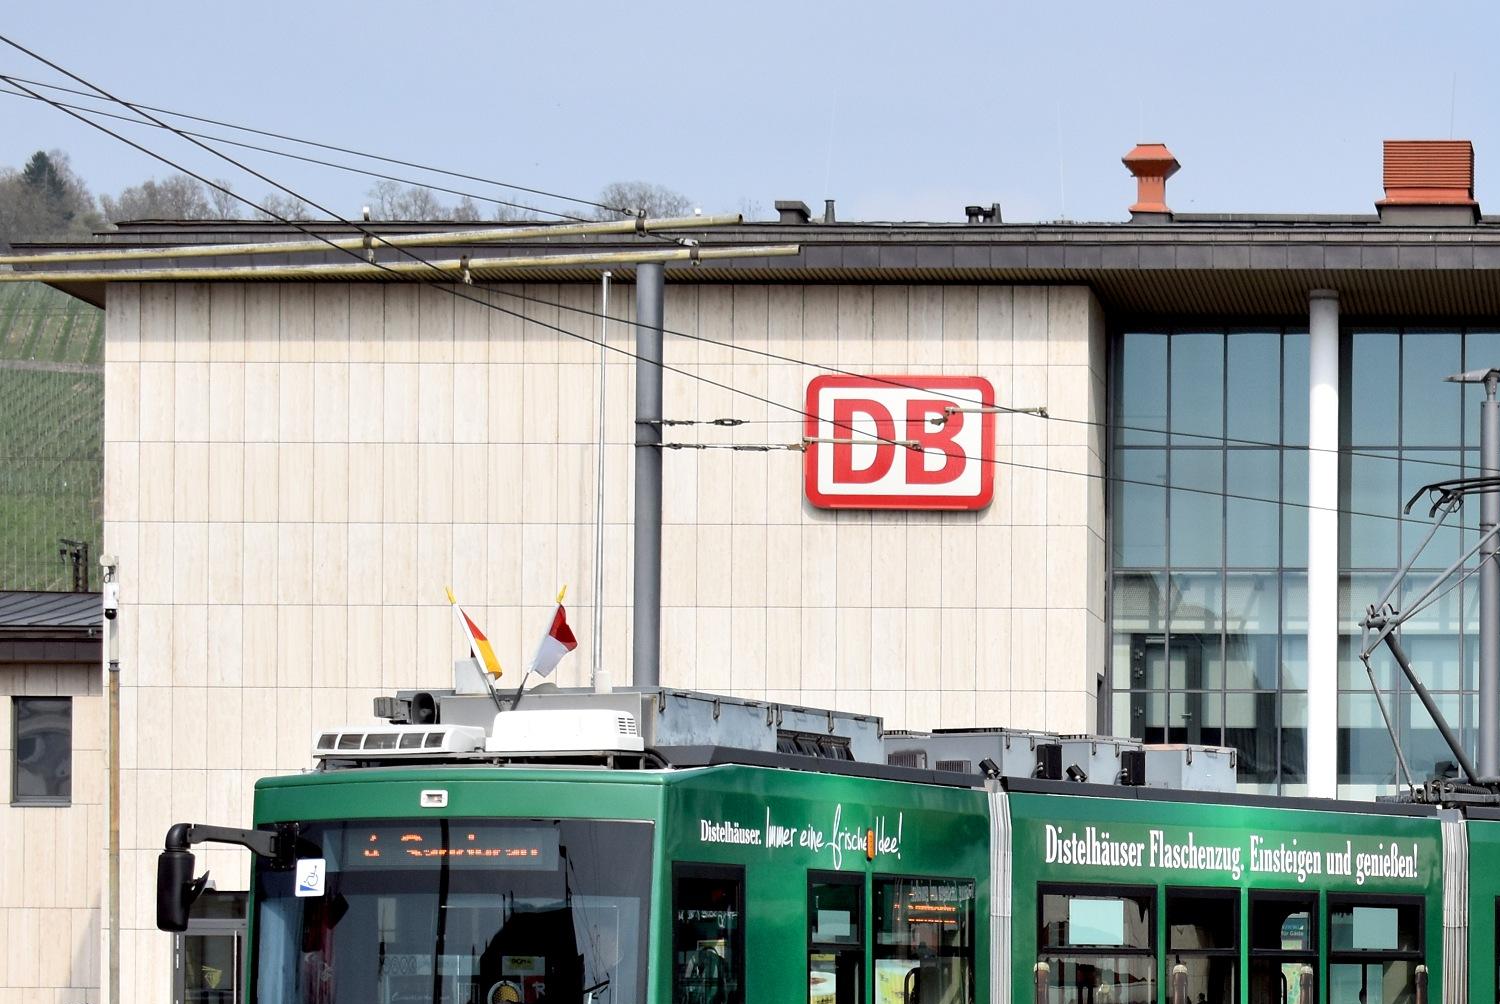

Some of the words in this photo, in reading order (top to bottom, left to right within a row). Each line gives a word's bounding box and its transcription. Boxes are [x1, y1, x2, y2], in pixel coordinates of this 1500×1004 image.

[833, 399, 966, 484] DB
[700, 819, 761, 845] Distelhäuser.
[765, 806, 797, 848] Immer
[799, 823, 824, 851] eine
[824, 803, 867, 870] frische
[875, 812, 903, 860] Idee!
[1045, 825, 1145, 867] Distelhäuser
[1149, 830, 1245, 880] Flaschenzug.
[1249, 835, 1321, 883] Einsteigen
[1326, 841, 1351, 876] und
[1356, 843, 1418, 885] genießen!
